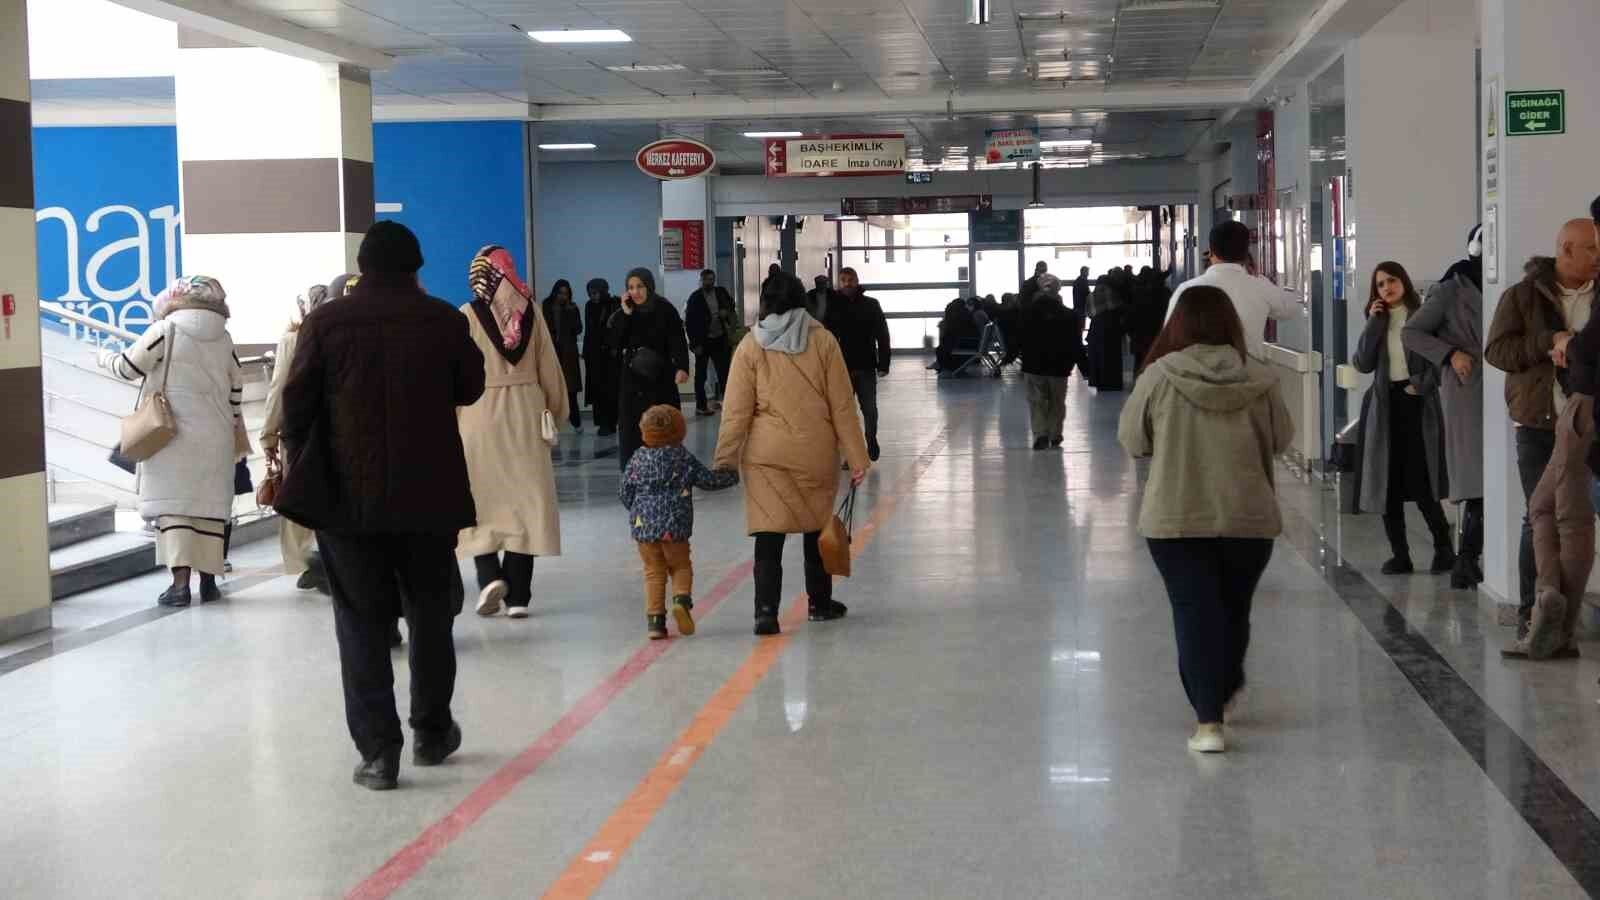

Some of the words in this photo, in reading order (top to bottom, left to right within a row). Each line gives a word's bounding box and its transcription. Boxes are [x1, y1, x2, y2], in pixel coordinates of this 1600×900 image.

[1510, 97, 1559, 108] SIĞINAĞA
[1519, 110, 1551, 120] GİDER
[800, 141, 884, 154] BAŞHEKİMLİK
[646, 152, 670, 166] MERKEZ
[671, 152, 706, 167] KAFETERYA
[873, 158, 897, 170] Onay
